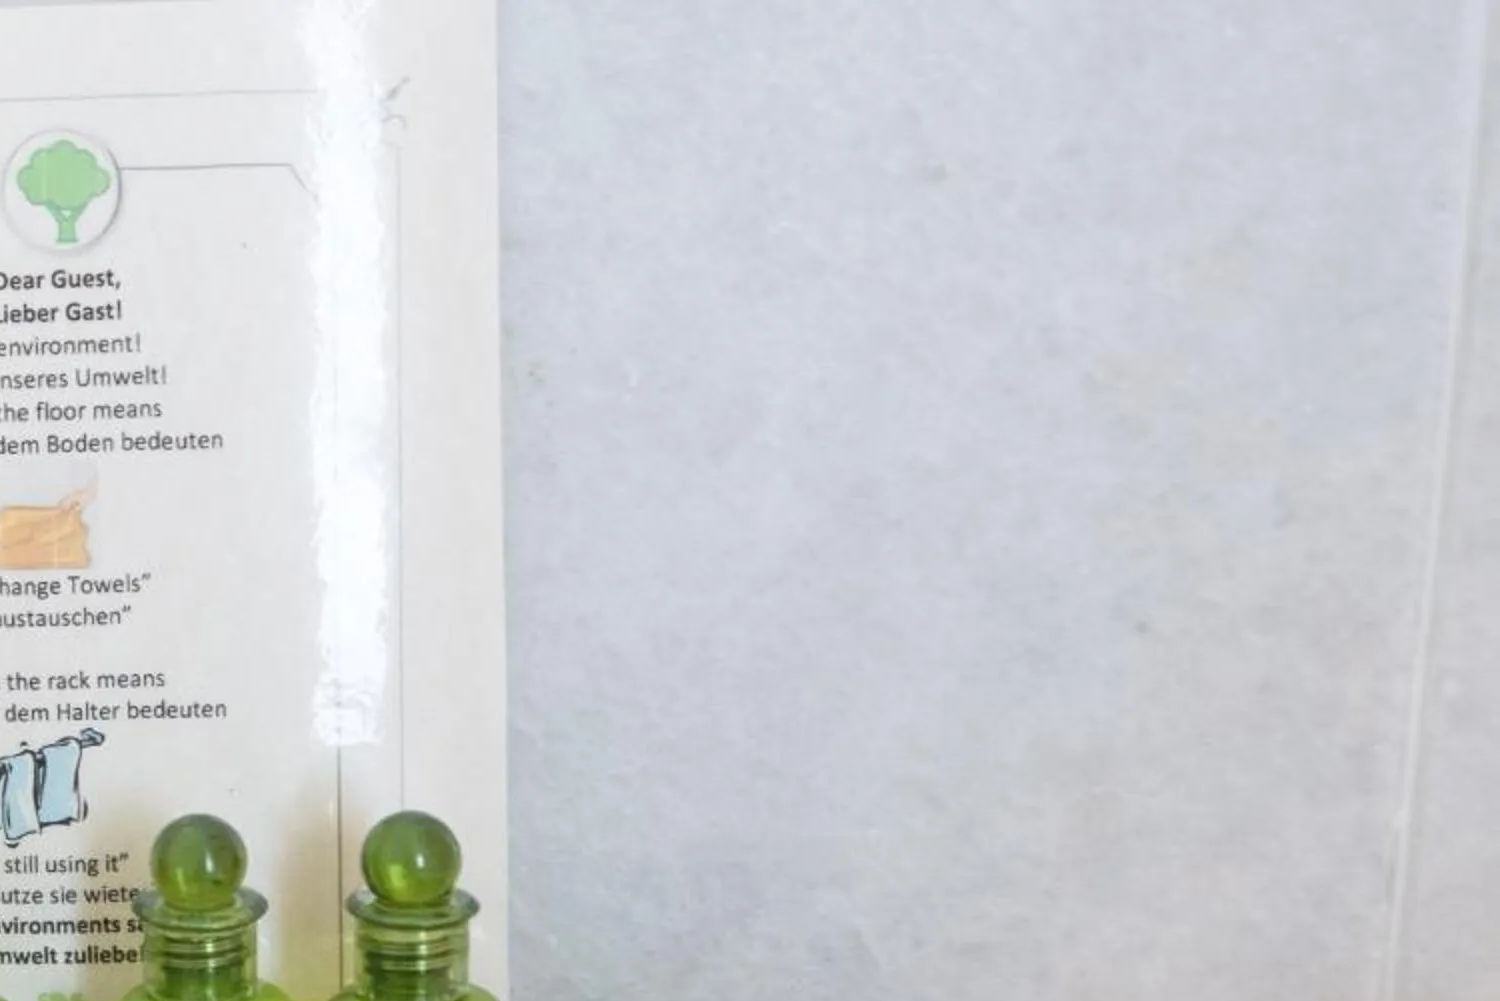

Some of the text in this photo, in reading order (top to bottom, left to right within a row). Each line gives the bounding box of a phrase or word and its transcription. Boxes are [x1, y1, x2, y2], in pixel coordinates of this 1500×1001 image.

[50, 269, 122, 291] Guest,
[65, 301, 123, 321] Gast!
[75, 368, 167, 388] Umwelt!
[35, 401, 86, 421] floor
[93, 402, 162, 419] means
[47, 435, 114, 453] Boden
[121, 431, 223, 452] bedeuten
[7, 672, 41, 691] the
[48, 670, 91, 690] rack
[97, 671, 165, 688] means
[5, 702, 50, 721] dem
[57, 702, 118, 721] Halter
[128, 700, 226, 720] bedeuten
[4, 855, 39, 874] still
[45, 855, 100, 876] using
[50, 886, 77, 904] sie
